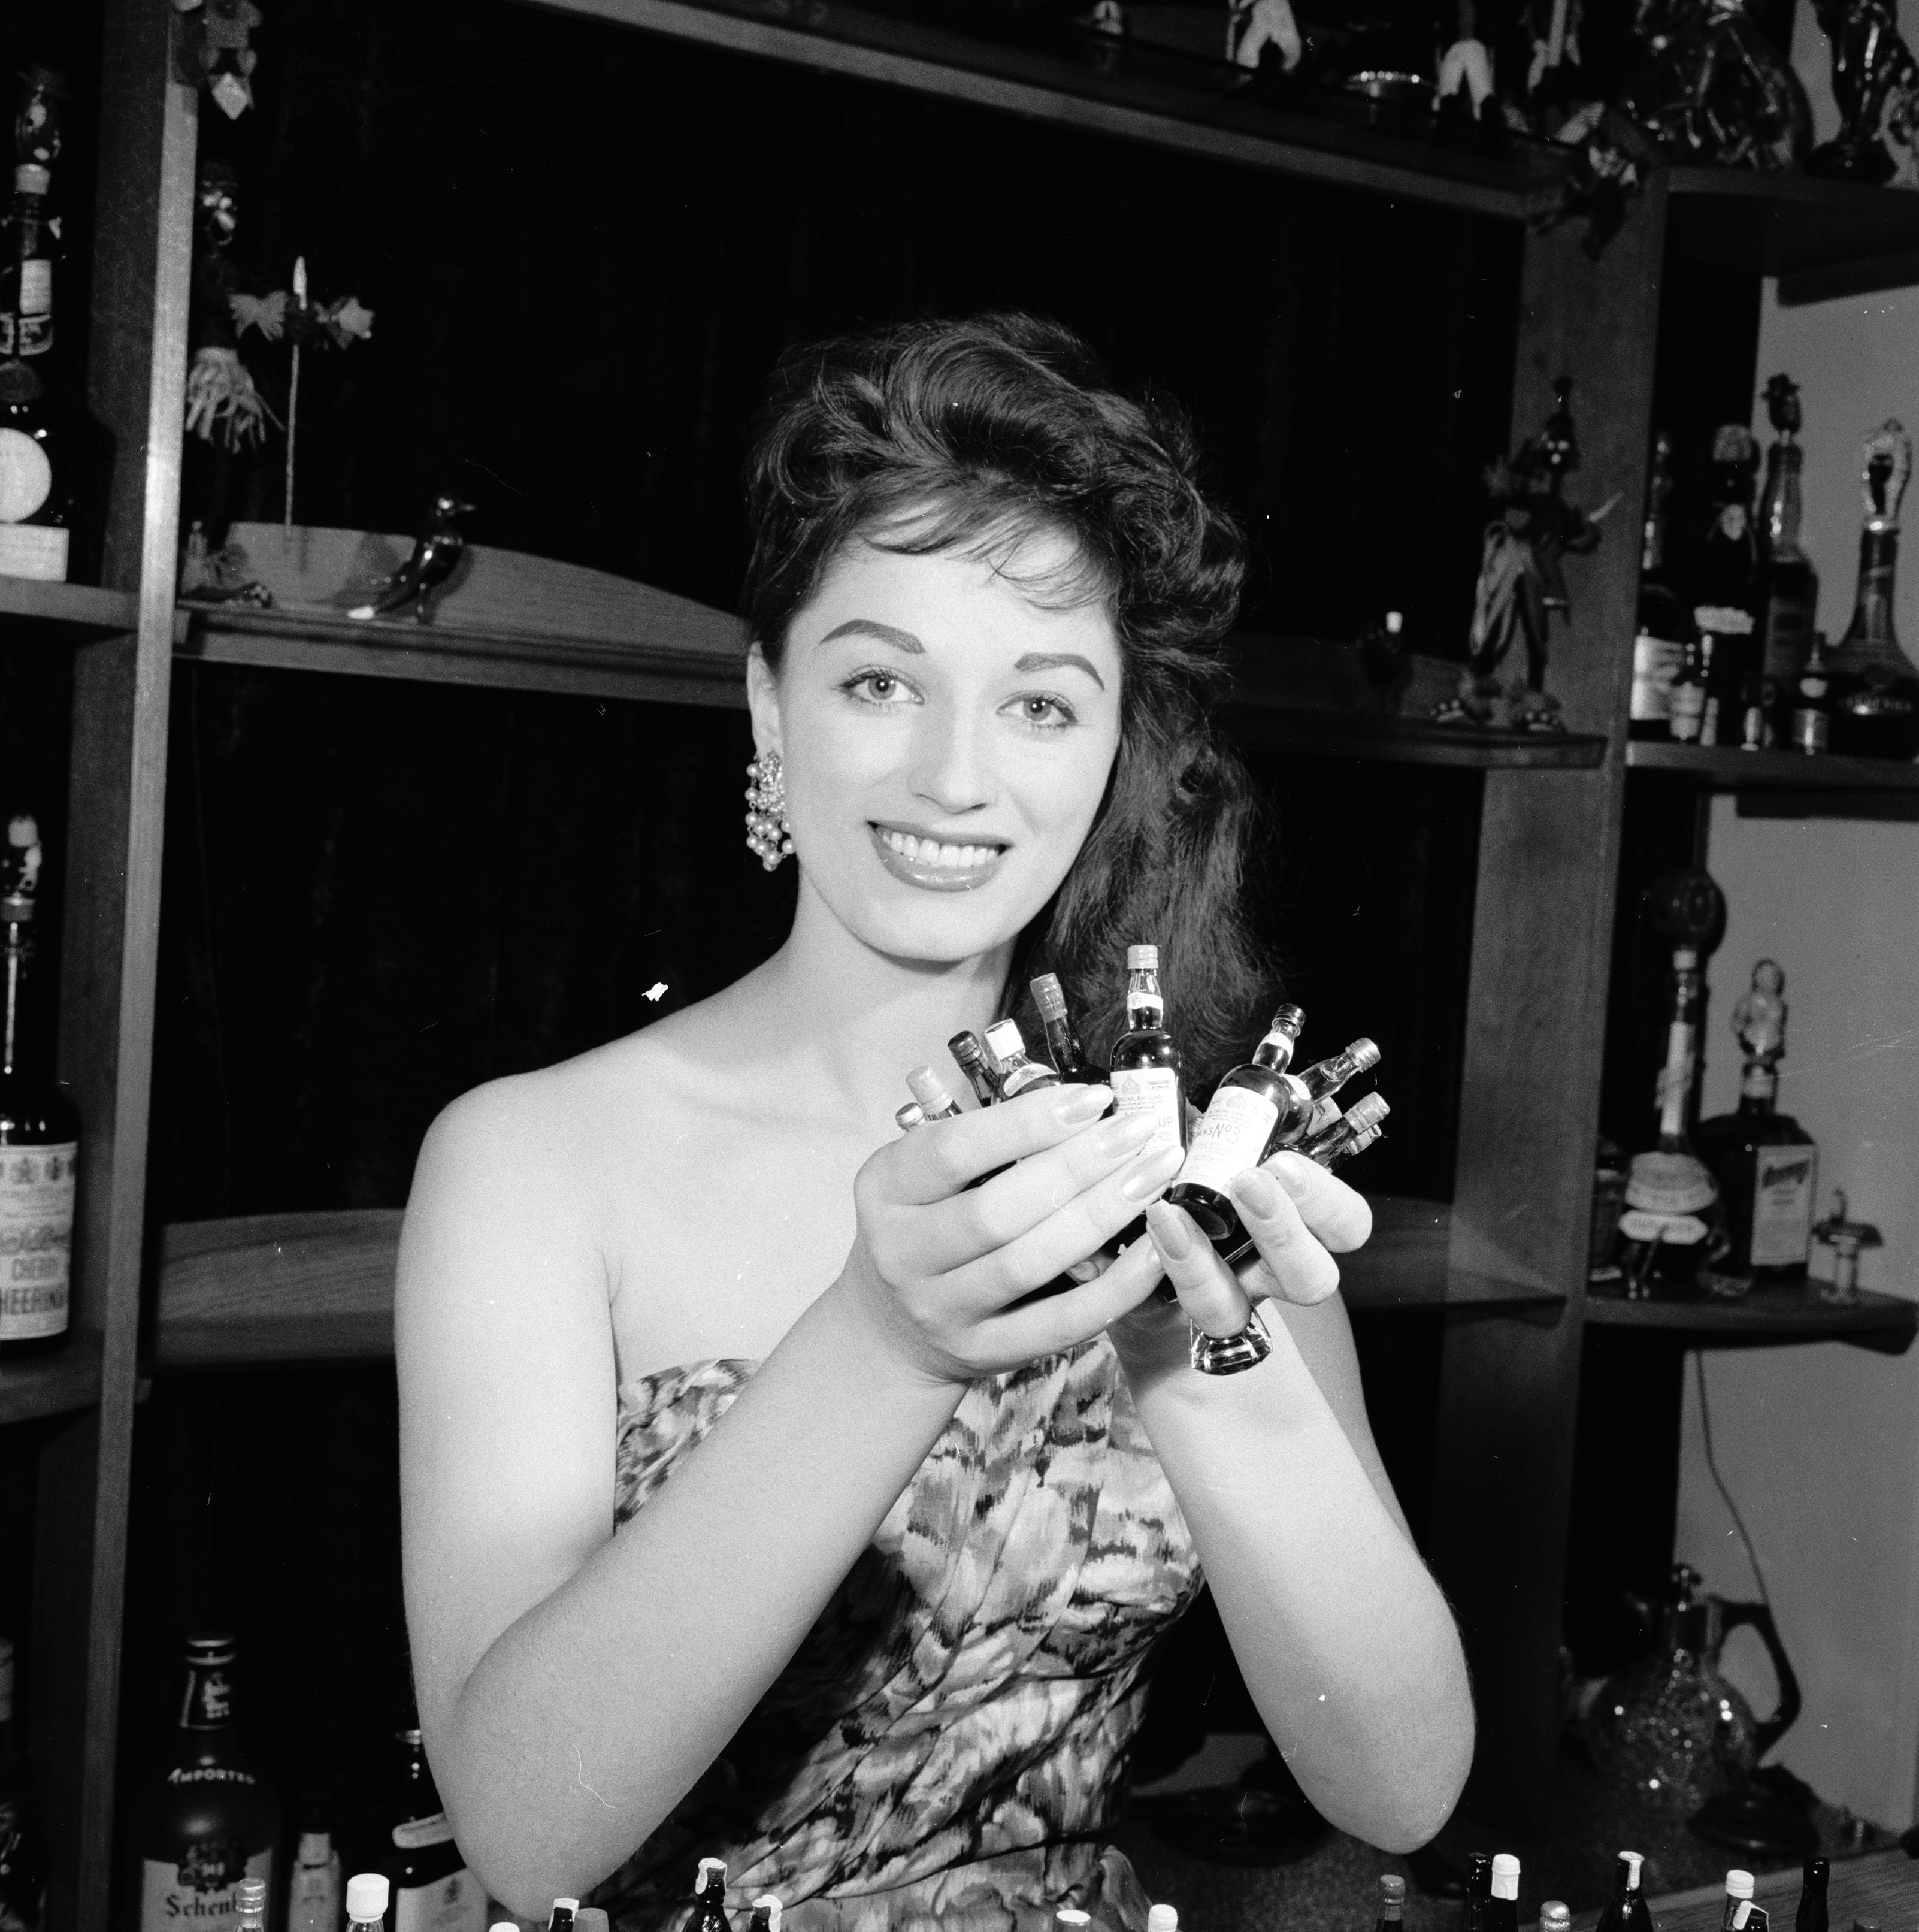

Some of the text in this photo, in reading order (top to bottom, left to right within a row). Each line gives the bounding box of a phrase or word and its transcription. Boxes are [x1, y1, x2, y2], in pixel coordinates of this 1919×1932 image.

[1158, 1117, 1173, 1127] UP
[167, 1768, 255, 1785] IMPORTED
[166, 1892, 237, 1918] Schenl
